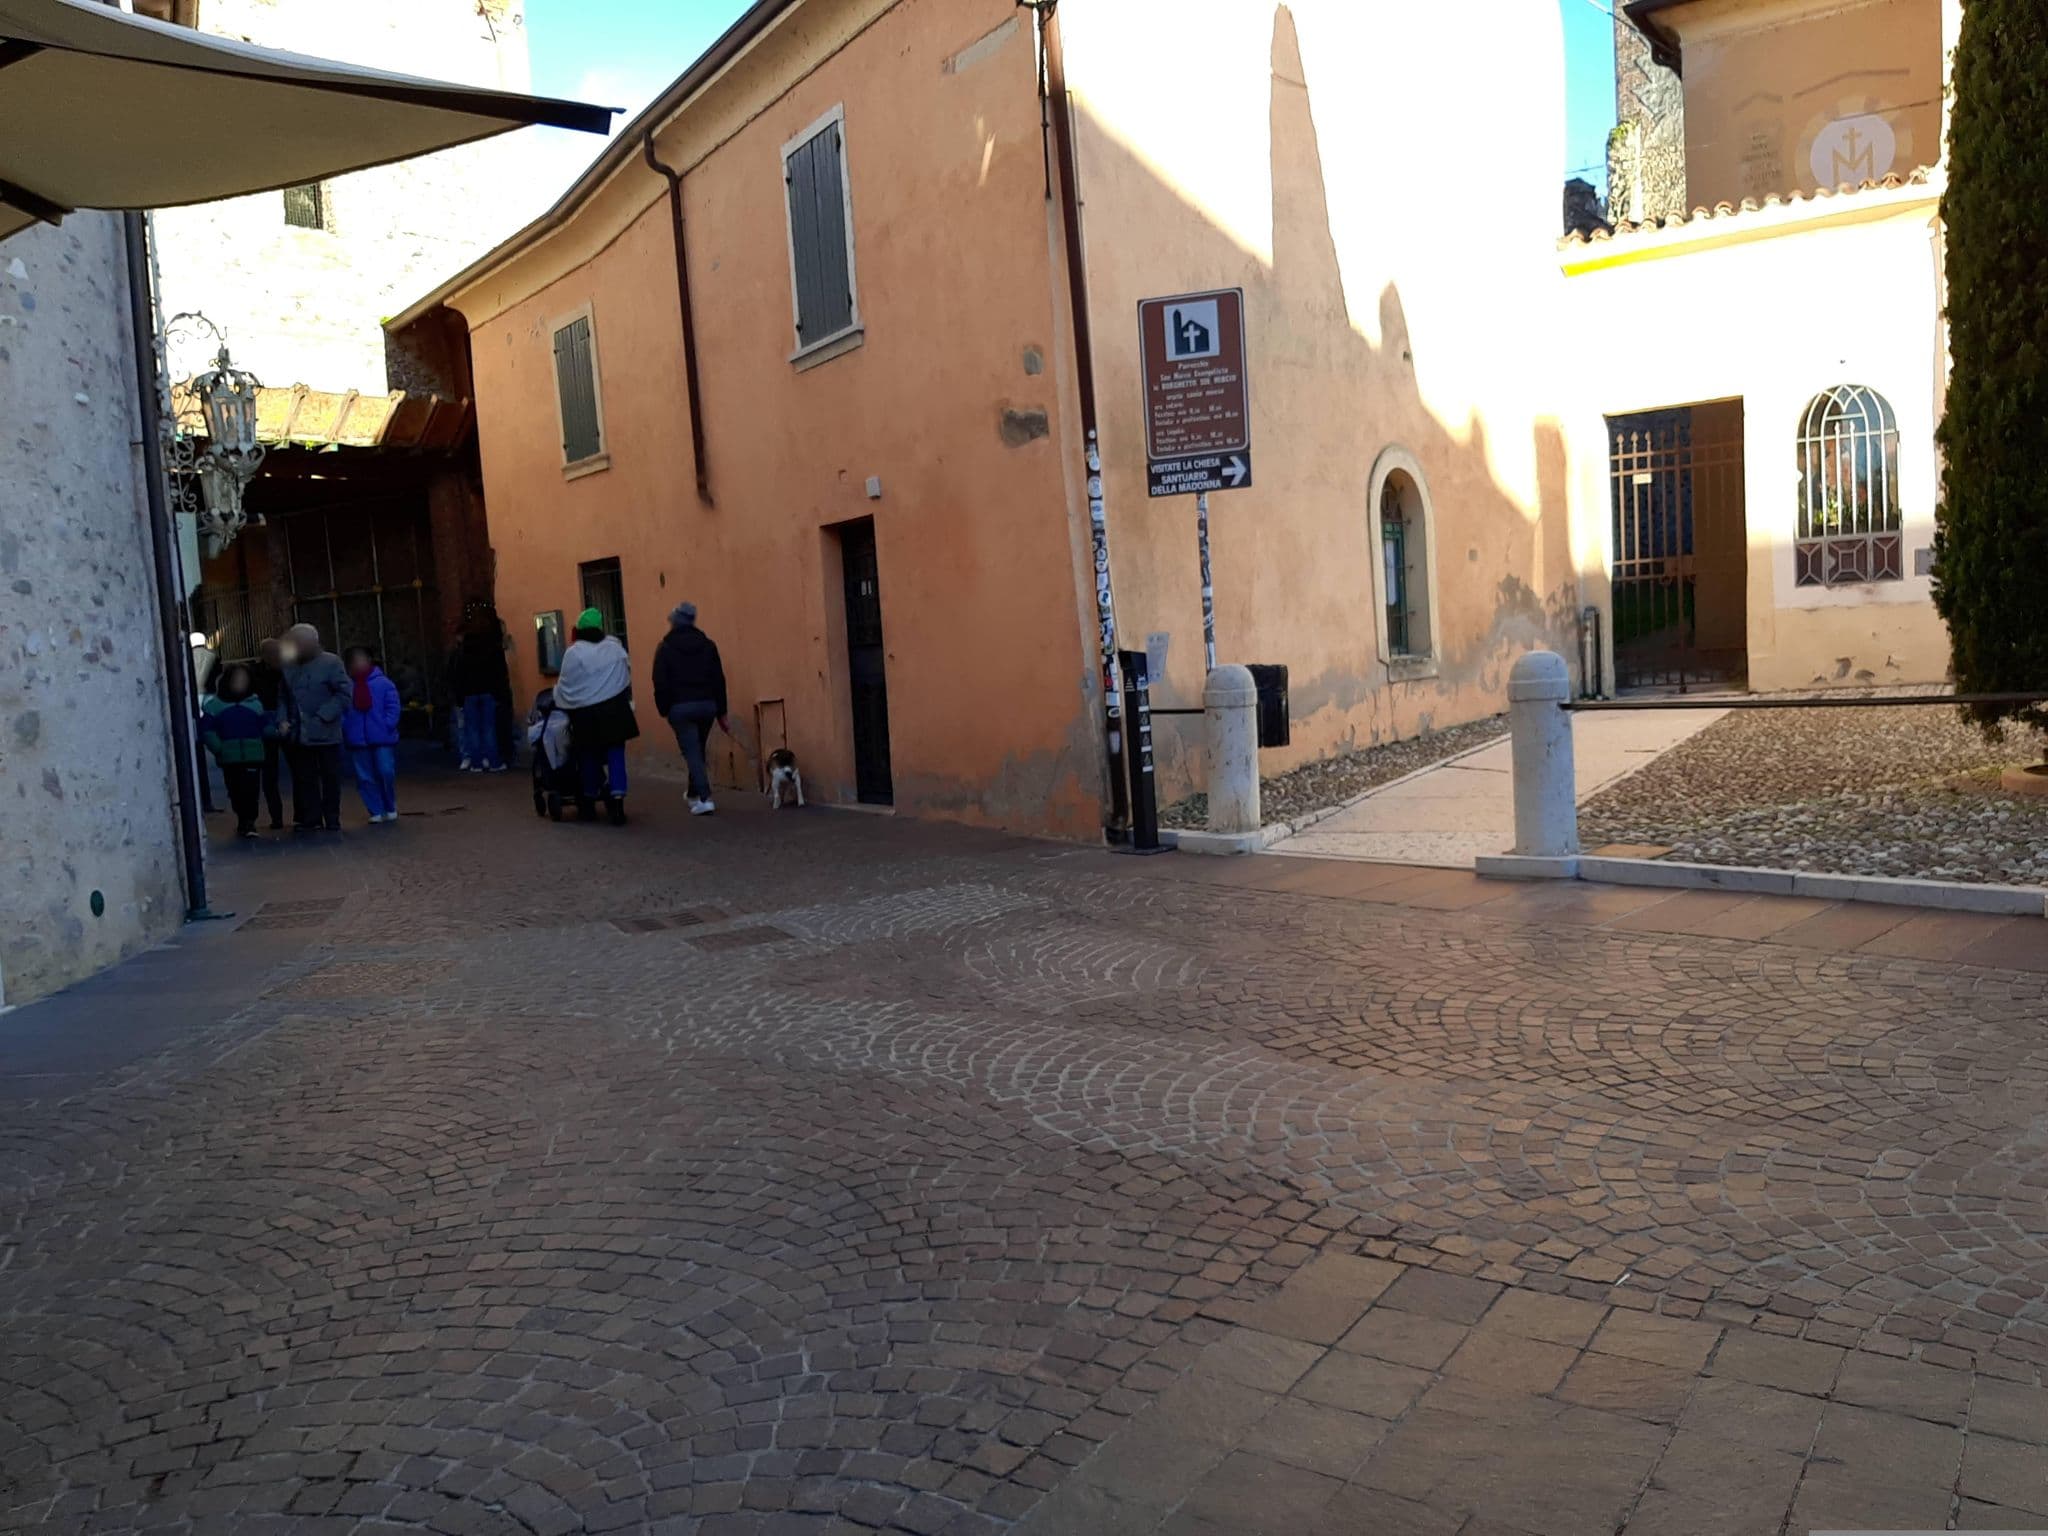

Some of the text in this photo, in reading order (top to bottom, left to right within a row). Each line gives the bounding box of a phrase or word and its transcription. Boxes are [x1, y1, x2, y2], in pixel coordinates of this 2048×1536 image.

[1150, 458, 1220, 473] VISITATE LA CHIESA
[1161, 471, 1208, 484] SANTUARIO
[1151, 479, 1221, 495] DELLA MADONNA
